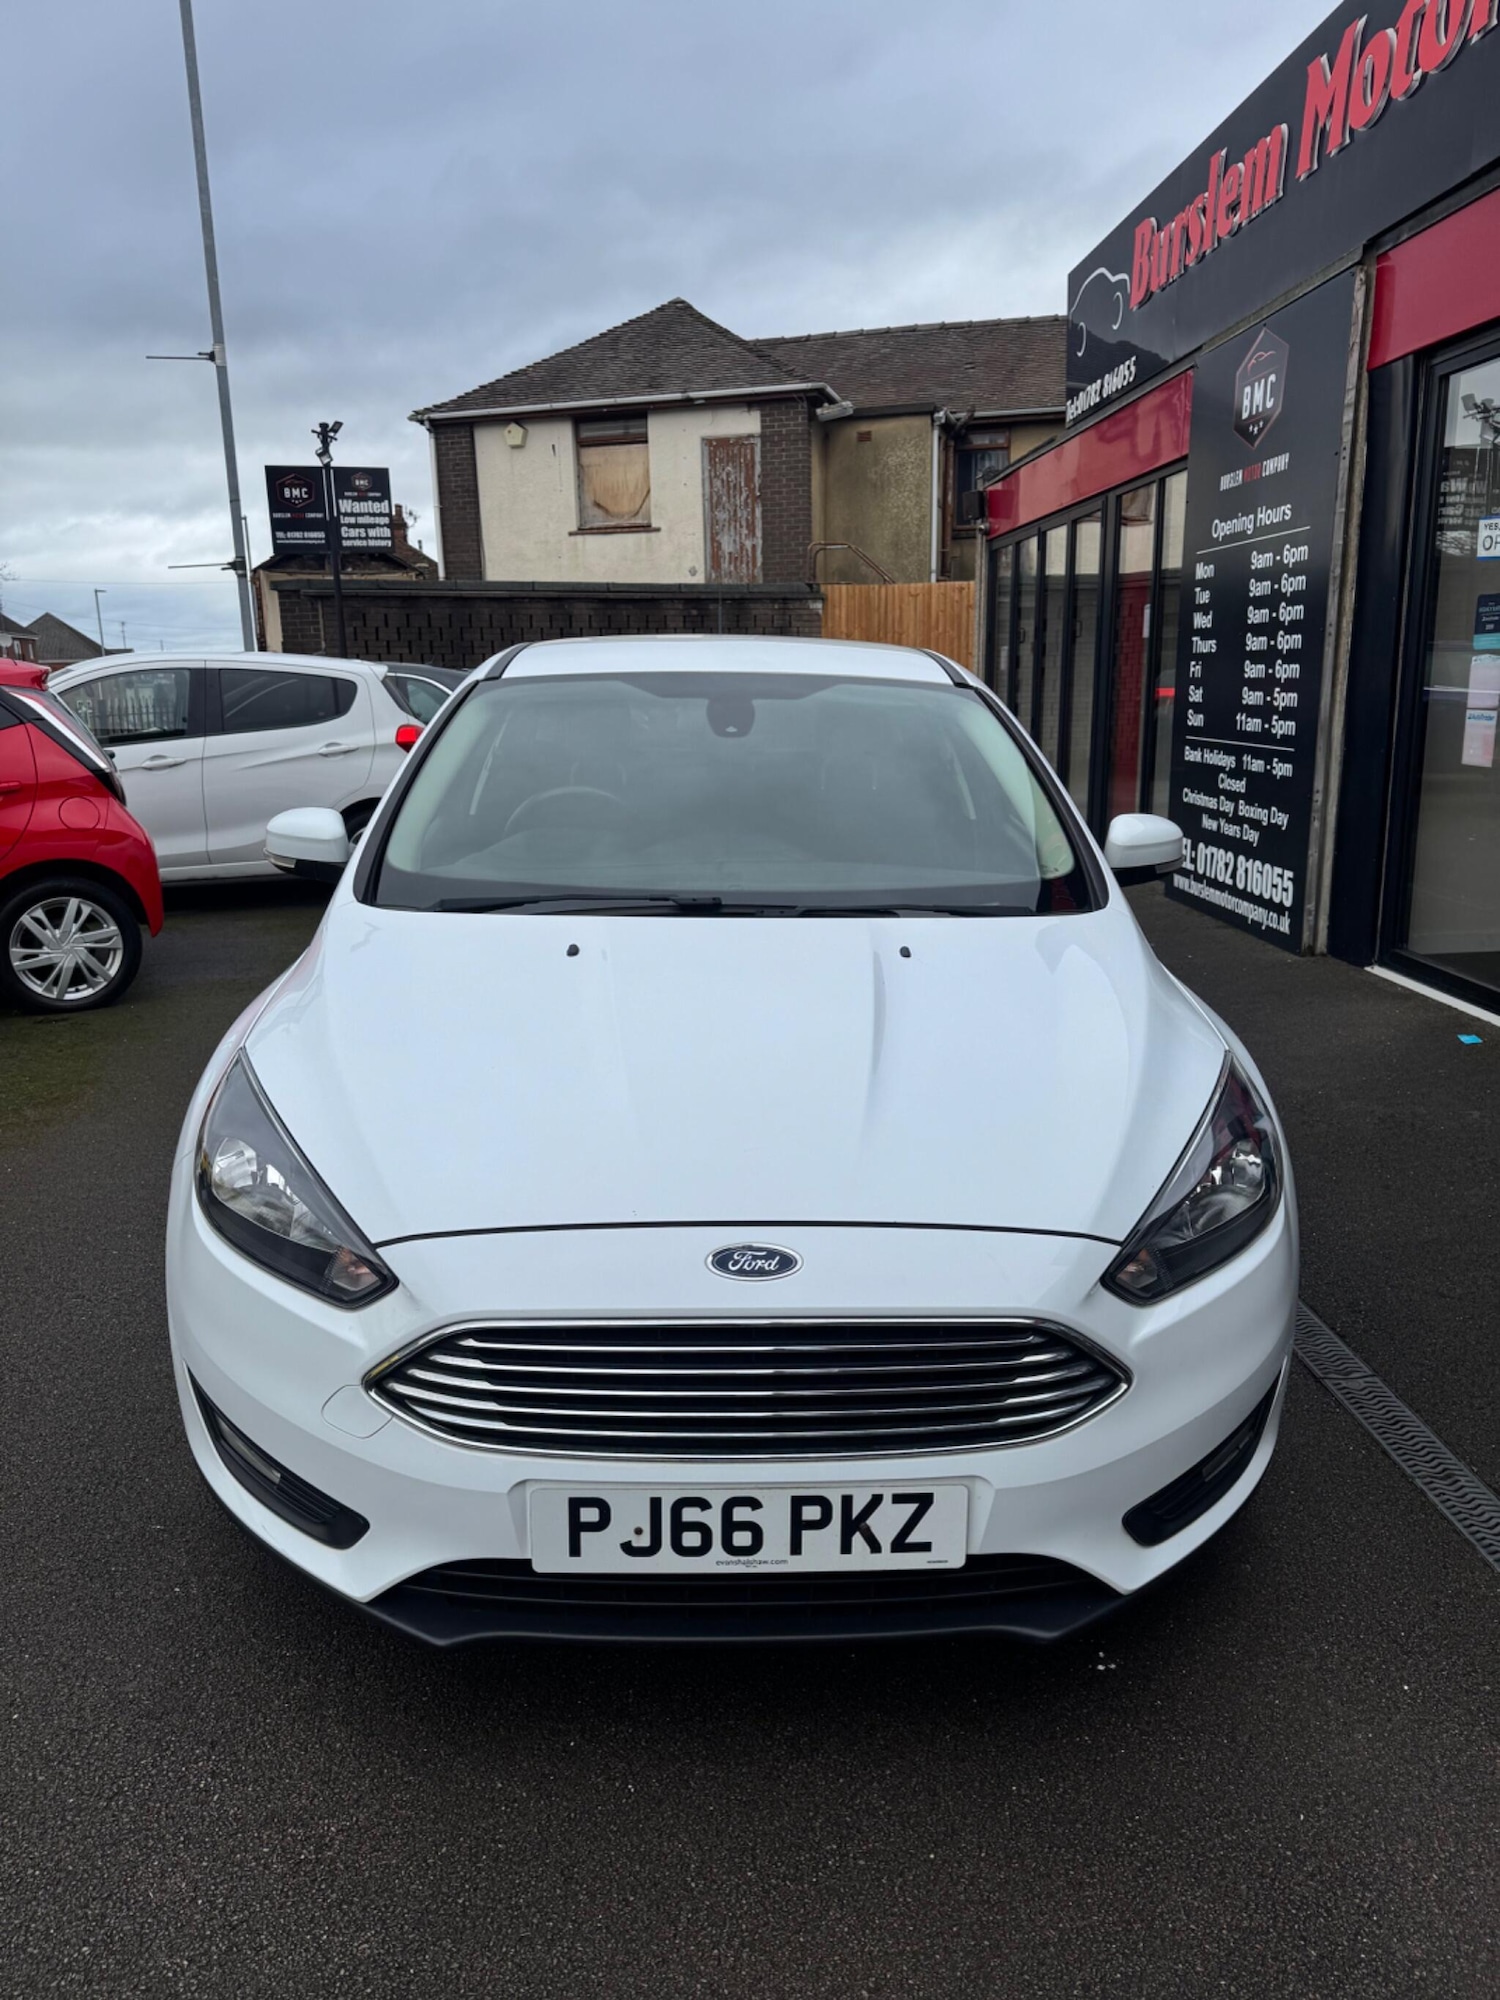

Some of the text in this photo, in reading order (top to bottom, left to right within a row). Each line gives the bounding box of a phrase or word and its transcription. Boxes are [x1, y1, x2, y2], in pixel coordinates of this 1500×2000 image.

[1129, 123, 1288, 310] Burslem
[1102, 356, 1137, 398] 816055
[1241, 374, 1277, 420] BMC
[1262, 452, 1290, 477] COMPANY
[283, 487, 309, 499] BMC
[338, 498, 390, 514] Wanted
[340, 515, 390, 526] Low mileage
[341, 526, 392, 538] Cars with
[1211, 503, 1292, 541] Opening Hours
[342, 538, 392, 548] service history
[1195, 562, 1215, 580] Mon
[1250, 550, 1273, 570] 9am
[1283, 544, 1309, 568] 6pm
[1194, 587, 1211, 604] Tue
[1248, 578, 1271, 597] 9am
[1281, 573, 1307, 597] 6pm
[1193, 610, 1213, 629] Wed
[1247, 605, 1270, 625] 9am
[1279, 601, 1304, 626] 6pm
[1191, 636, 1217, 654] Thurs
[1245, 632, 1268, 651] 9am
[1277, 630, 1302, 655] 6pm
[1189, 661, 1202, 678] Fri
[1244, 660, 1266, 679] 9am
[1275, 659, 1300, 683] 6pm
[1188, 685, 1203, 703] Sat
[1242, 686, 1264, 706] 9am
[1272, 687, 1298, 711] 5pm
[1187, 709, 1204, 727] Sun
[1236, 712, 1262, 732] 11am
[1271, 715, 1296, 739] 5pm
[1184, 745, 1202, 763] Bank
[1203, 748, 1236, 771] Holidays
[1242, 753, 1265, 773] 11am
[1272, 757, 1293, 780] 5pm
[1218, 772, 1247, 793] Closed
[1182, 787, 1290, 831] Christmas Day Boxing Day
[1202, 813, 1260, 848] New Years Day
[1182, 837, 1294, 908] EL: 01782 816055
[728, 1251, 780, 1271] Ford
[567, 1493, 935, 1557] PJ66 PKZ
